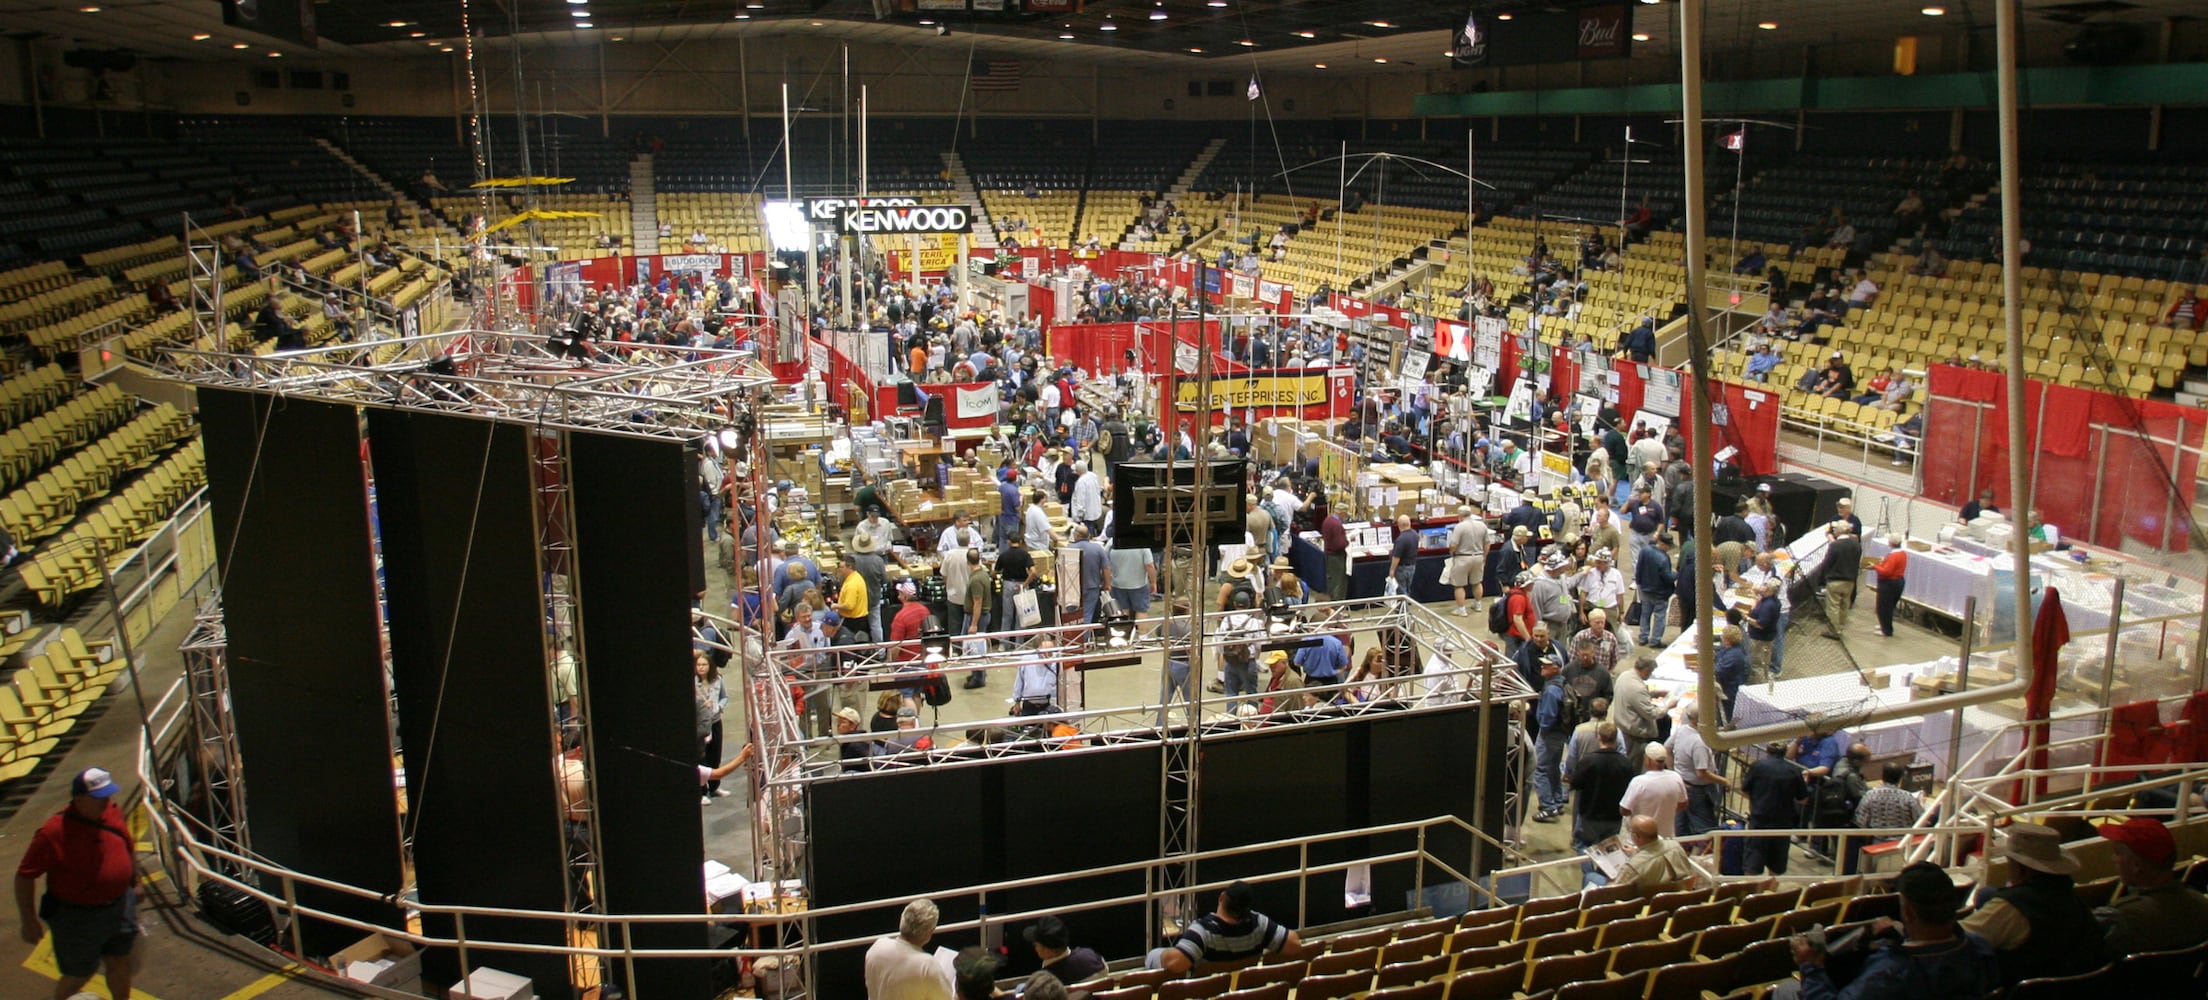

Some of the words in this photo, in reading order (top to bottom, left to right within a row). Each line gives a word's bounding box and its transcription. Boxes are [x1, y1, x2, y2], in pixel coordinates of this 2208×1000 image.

[1578, 17, 1620, 46] Bud
[1455, 44, 1486, 57] LIGHT
[844, 209, 967, 231] KENWOOD
[907, 258, 946, 266] AERICA
[1435, 321, 1470, 361] DX
[965, 397, 992, 408] ICOM
